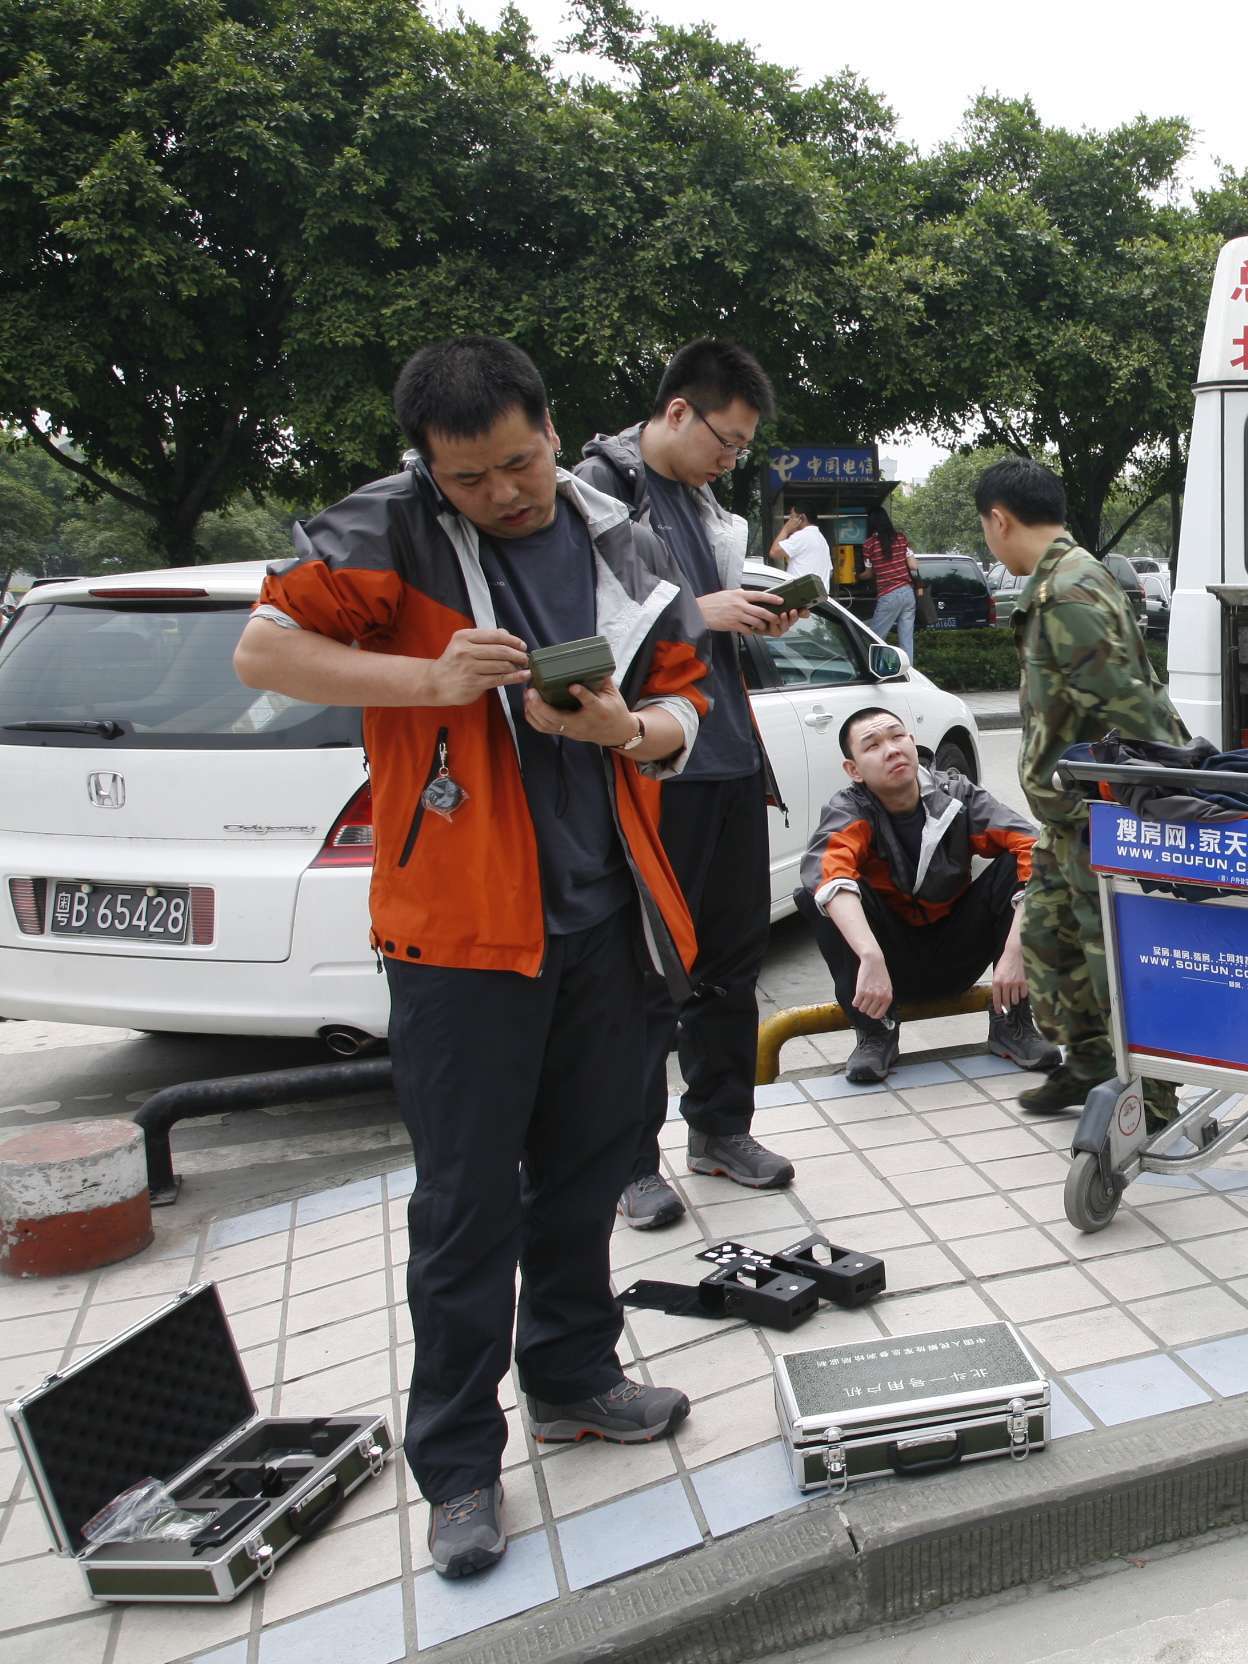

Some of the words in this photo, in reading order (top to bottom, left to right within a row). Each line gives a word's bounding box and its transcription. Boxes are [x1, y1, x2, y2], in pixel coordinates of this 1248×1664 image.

[807, 456, 874, 475] 中国电信
[843, 1368, 989, 1398] 北斗一号用户机
